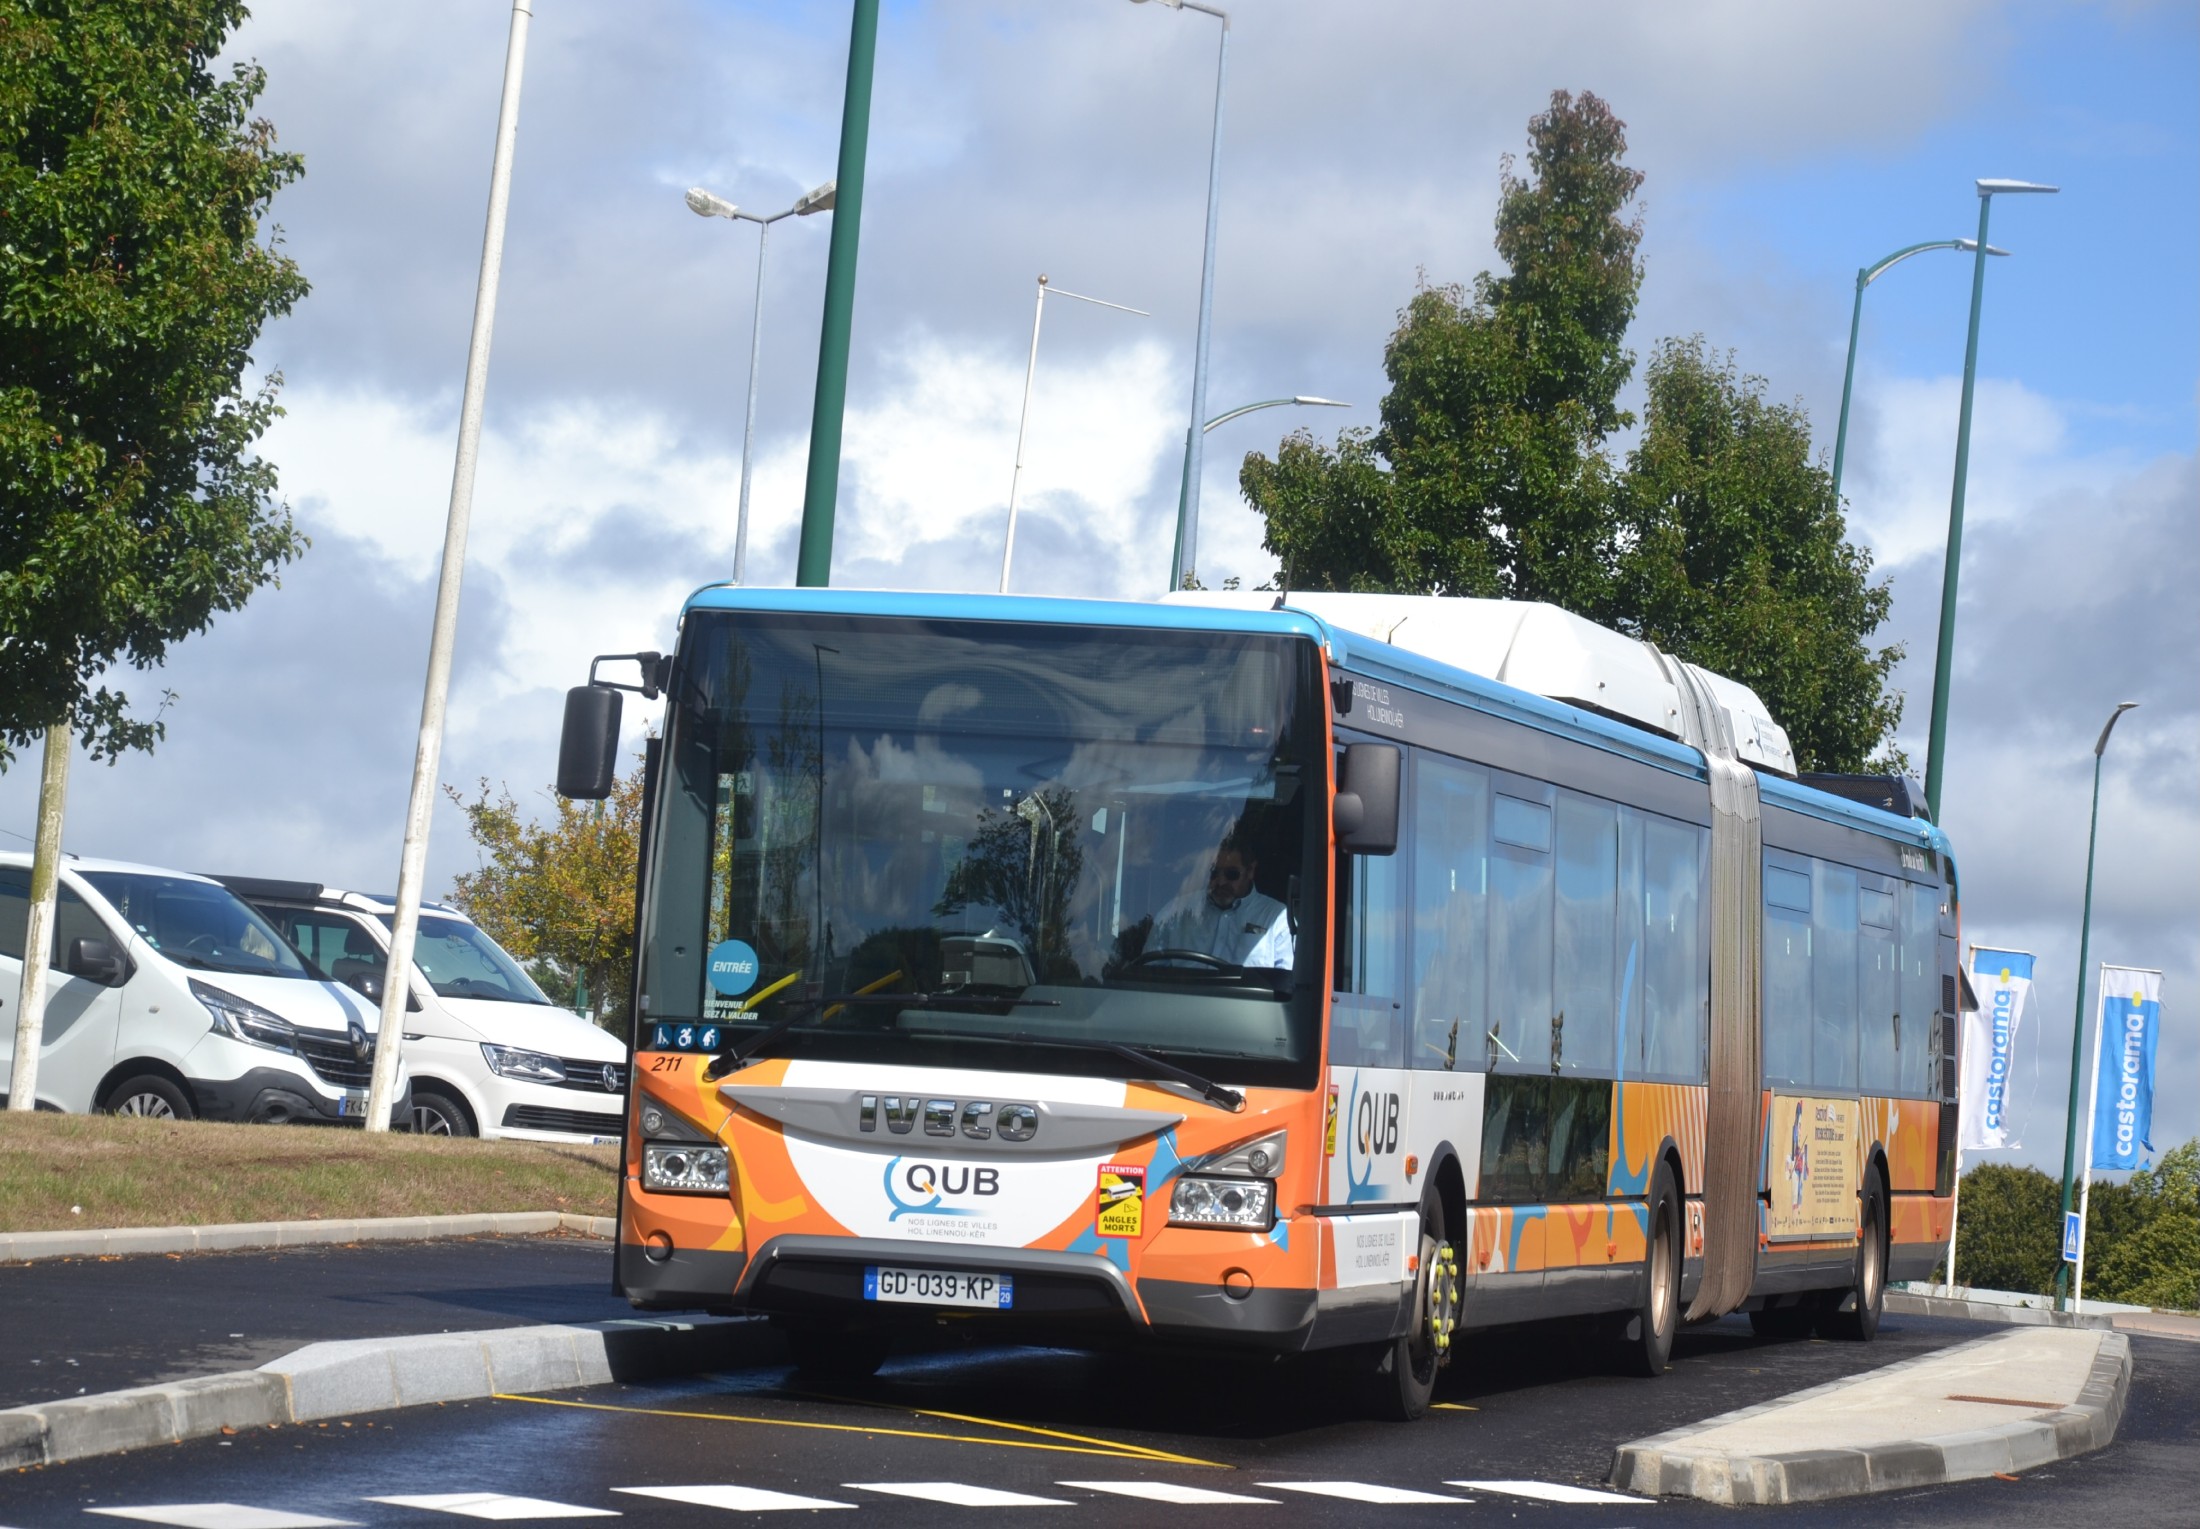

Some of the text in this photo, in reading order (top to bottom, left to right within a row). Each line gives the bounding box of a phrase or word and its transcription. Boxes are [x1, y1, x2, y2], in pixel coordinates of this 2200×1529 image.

[712, 960, 752, 974] ENTRÉE
[728, 1012, 758, 1020] VALIDER
[651, 1056, 682, 1071] 211
[1986, 989, 2011, 1130] castorama
[2116, 1013, 2145, 1157] castorama
[860, 1095, 1038, 1142] IVECO
[1357, 1090, 1399, 1157] QUB
[1101, 1165, 1144, 1175] ATTENTION
[906, 1164, 999, 1196] QUB
[908, 1218, 925, 1226] NOS
[927, 1219, 956, 1228] LIGNES
[971, 1222, 998, 1230] VILLES
[1103, 1215, 1137, 1225] ANGLES
[1104, 1224, 1135, 1232] MORTS
[881, 1271, 994, 1300] GD-039-KP
[1000, 1292, 1011, 1303] 29
